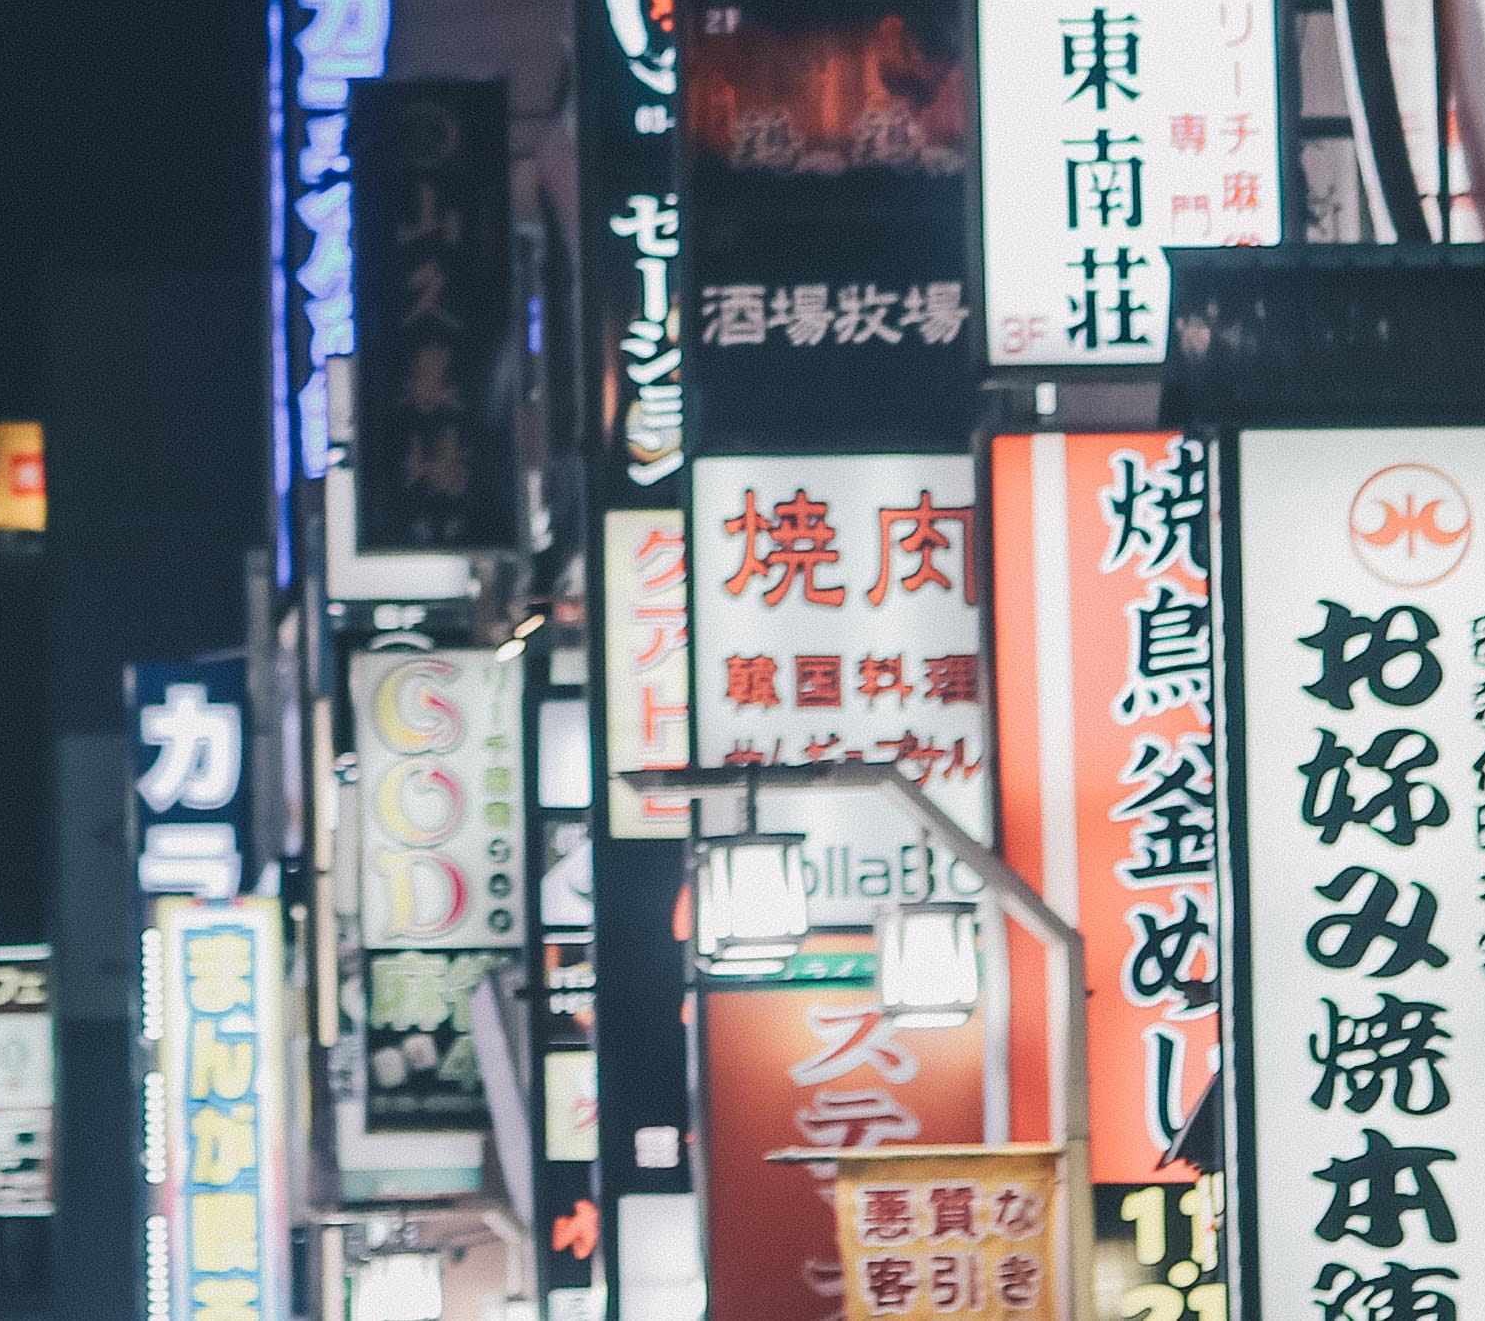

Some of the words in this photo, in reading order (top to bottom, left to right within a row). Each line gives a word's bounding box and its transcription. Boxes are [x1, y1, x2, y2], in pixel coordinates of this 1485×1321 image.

[1219, 3, 1261, 247] リーチ麻
[1057, 6, 1152, 350] 東南荘
[701, 281, 970, 347] 酒場牧場
[723, 486, 976, 608] 焼肉
[724, 653, 978, 707] 韓国料理
[860, 1185, 1040, 1245] 悪質な
[862, 1254, 1040, 1315] 客引き
